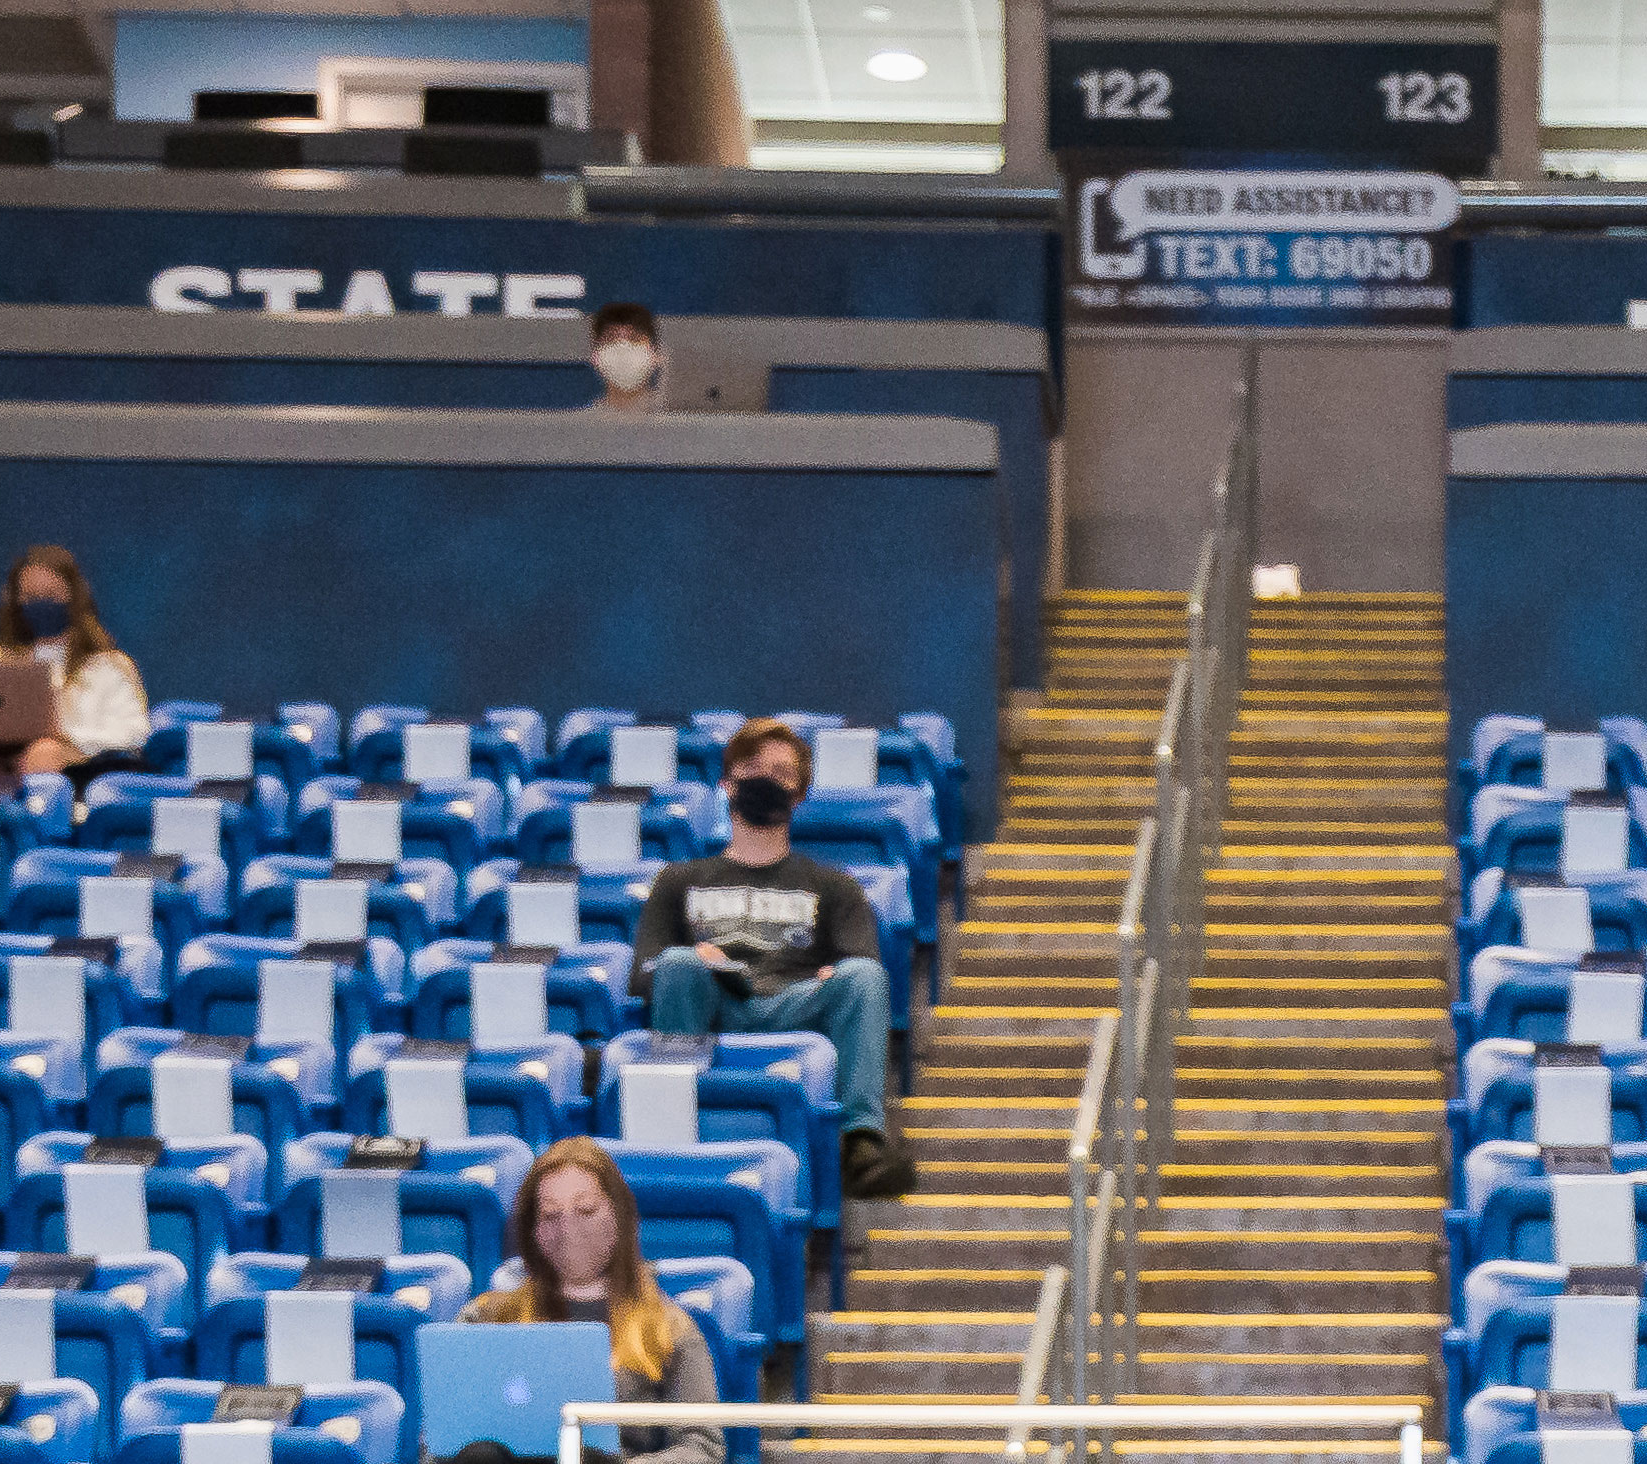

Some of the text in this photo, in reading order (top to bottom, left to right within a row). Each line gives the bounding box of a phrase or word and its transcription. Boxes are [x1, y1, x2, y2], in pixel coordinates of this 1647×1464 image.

[1077, 69, 1173, 119] 122
[1378, 72, 1472, 123] 123
[1146, 186, 1434, 218] NEED ASSISTANCE?
[1160, 236, 1433, 279] TEXT: 69050
